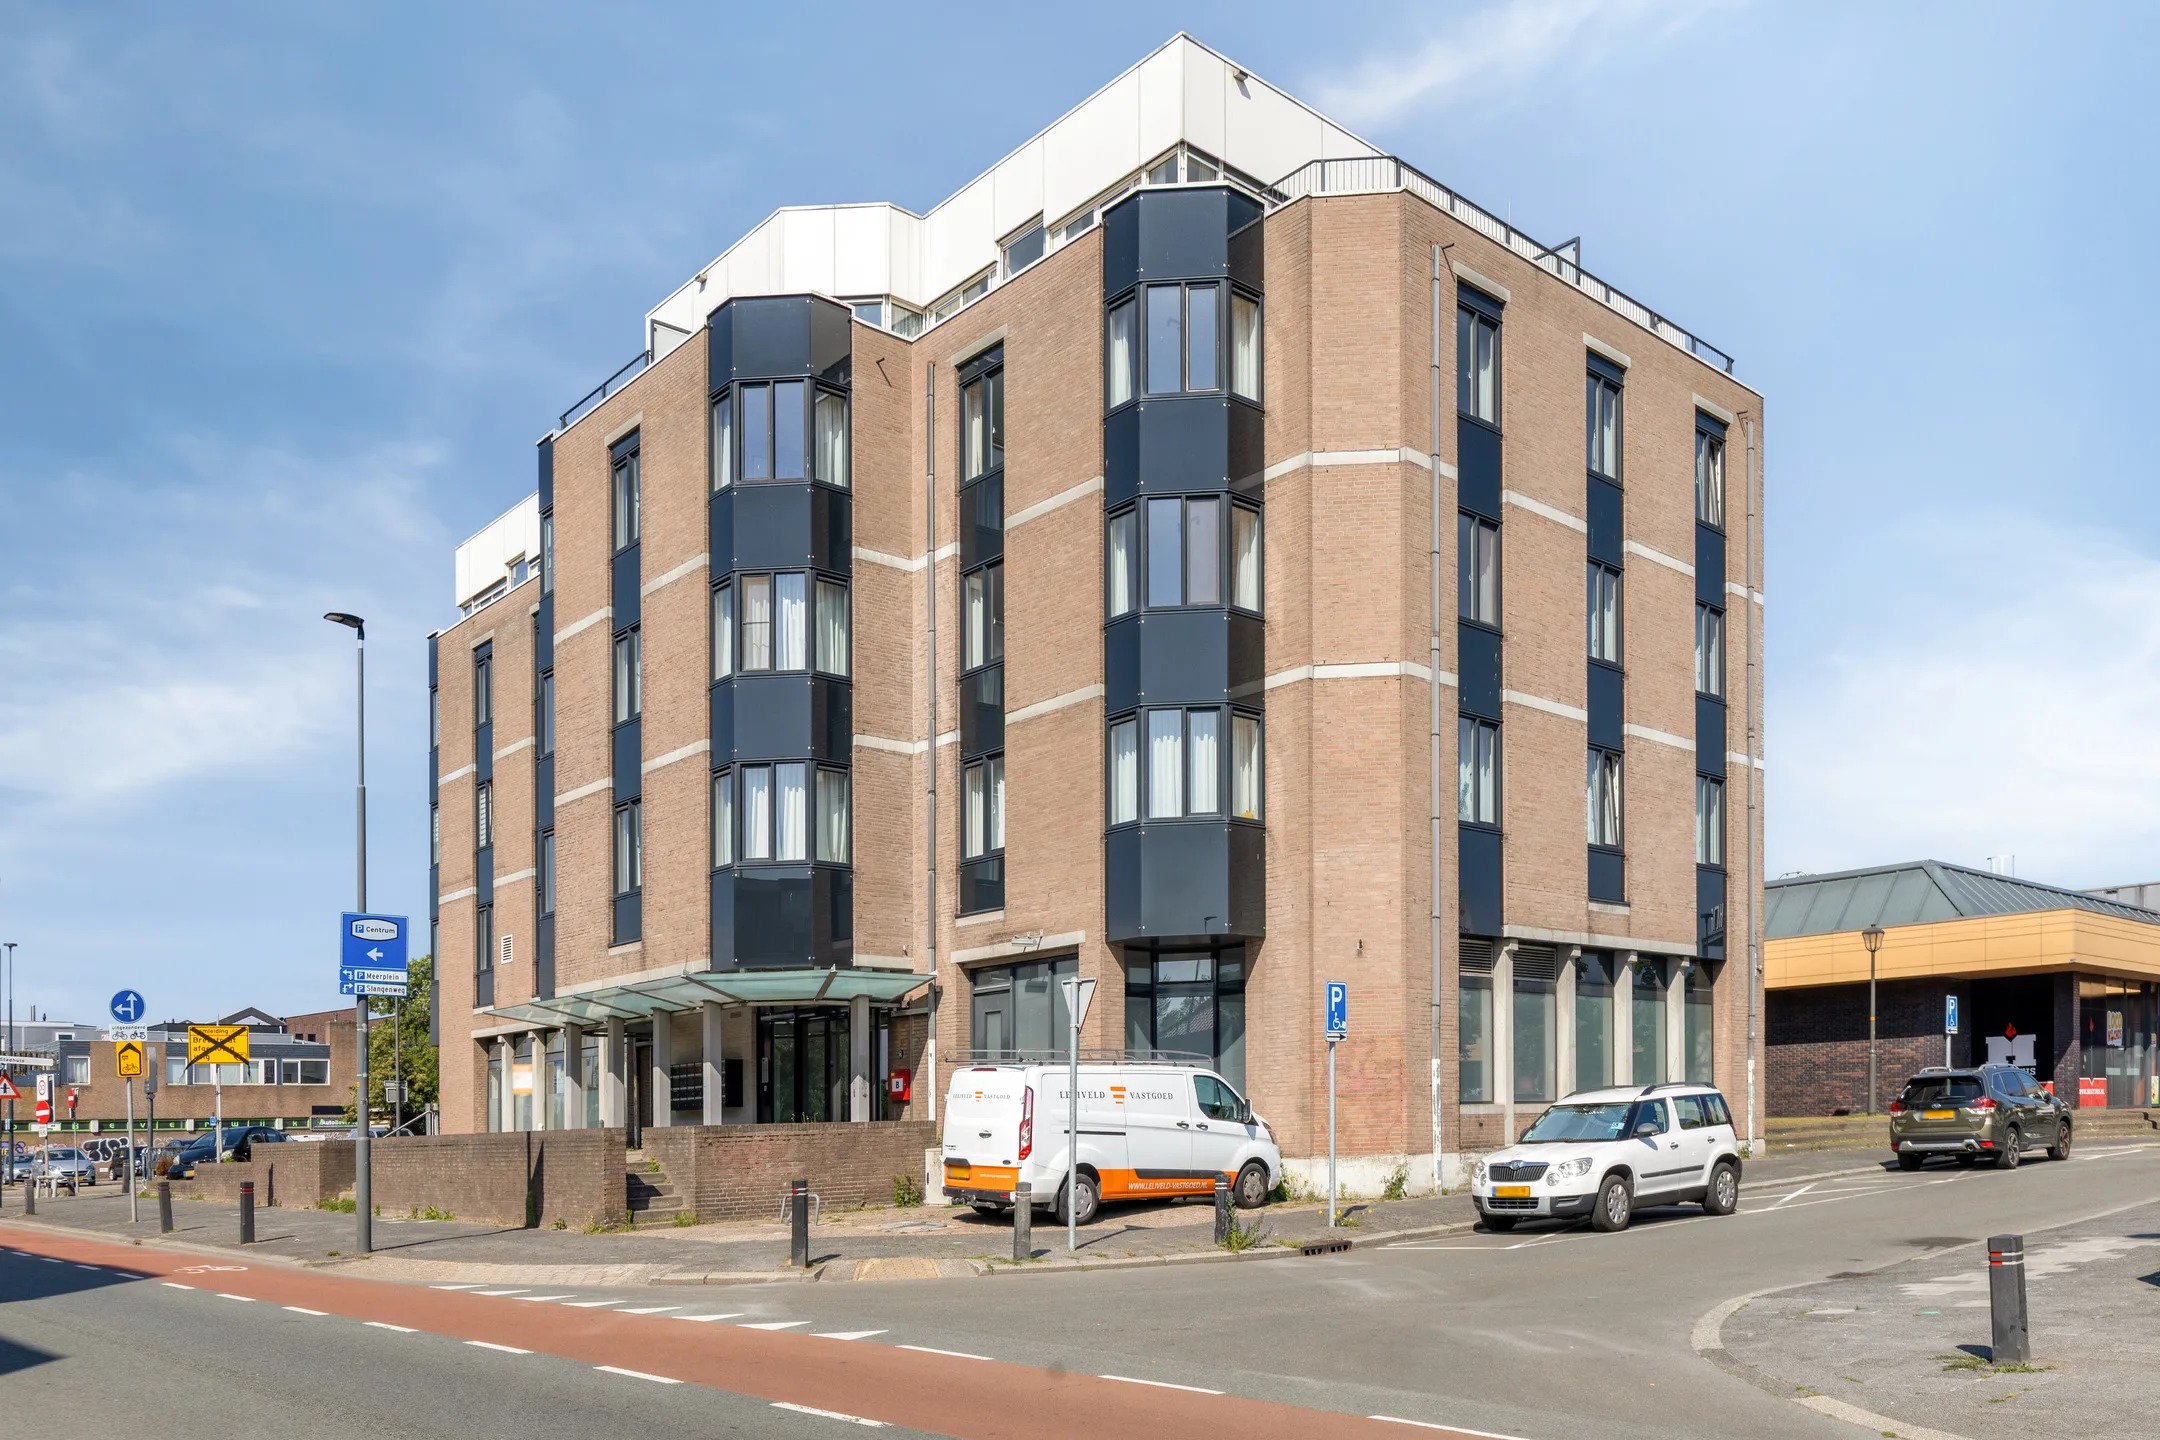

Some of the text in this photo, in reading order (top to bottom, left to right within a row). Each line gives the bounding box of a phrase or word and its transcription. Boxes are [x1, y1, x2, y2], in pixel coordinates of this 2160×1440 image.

[365, 926, 396, 934] Centrum
[366, 972, 400, 981] Meerplein
[366, 984, 406, 995] Slangenweg
[1331, 986, 1343, 1011] P
[2107, 1011, 2123, 1029] LOCO
[895, 1080, 900, 1089] B
[1059, 1091, 1174, 1100] LEIVELD VASTGOED
